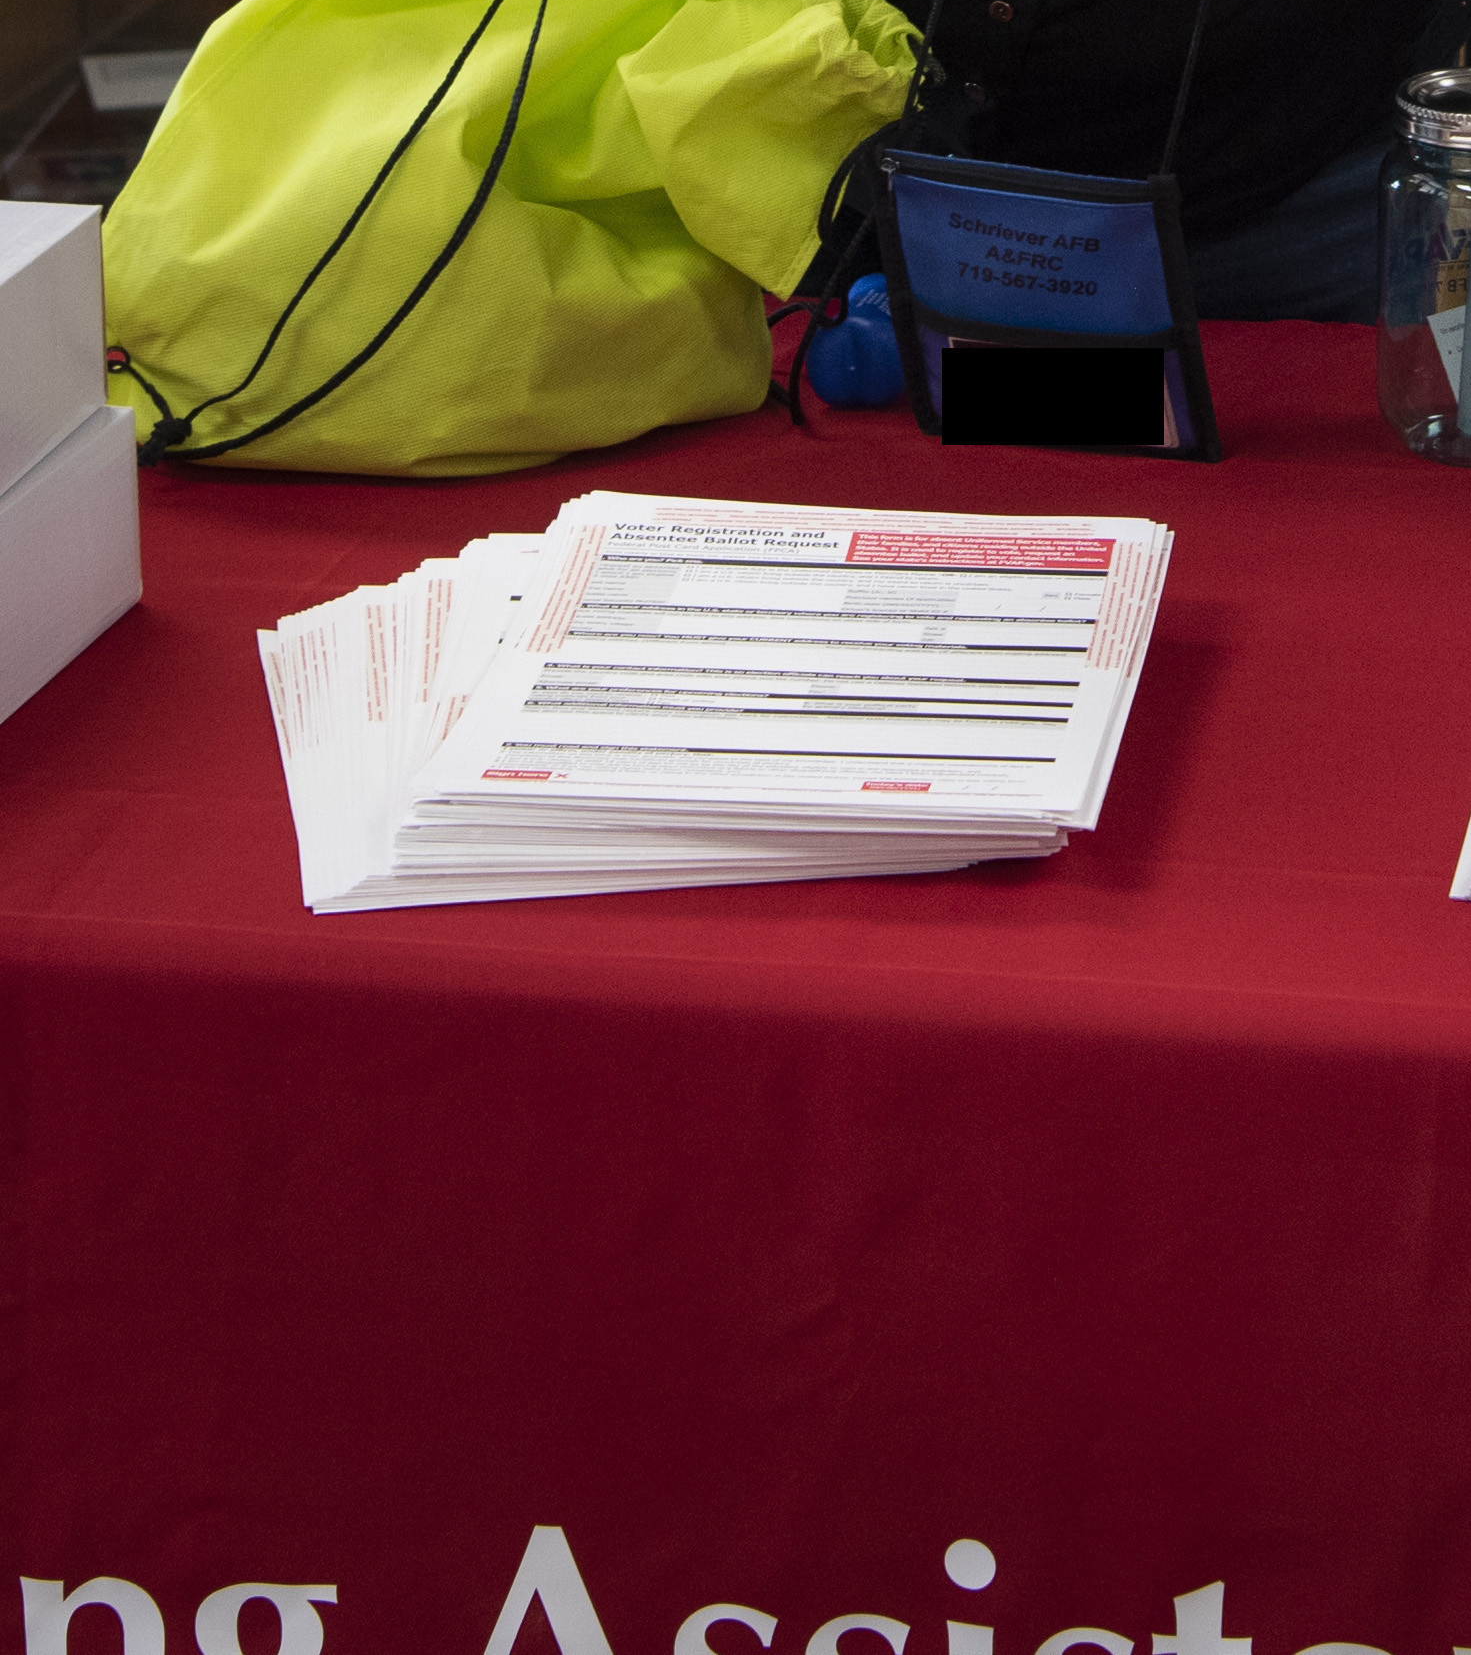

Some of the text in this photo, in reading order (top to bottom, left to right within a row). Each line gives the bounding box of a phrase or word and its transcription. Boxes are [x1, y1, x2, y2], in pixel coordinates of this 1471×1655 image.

[948, 211, 1100, 253] Schriever AFB
[985, 246, 1063, 271] A&FRC
[958, 261, 1098, 296] 719-567-3920
[610, 532, 840, 548] Absentee Ballot Request
[613, 523, 825, 538] Voter Registration and
